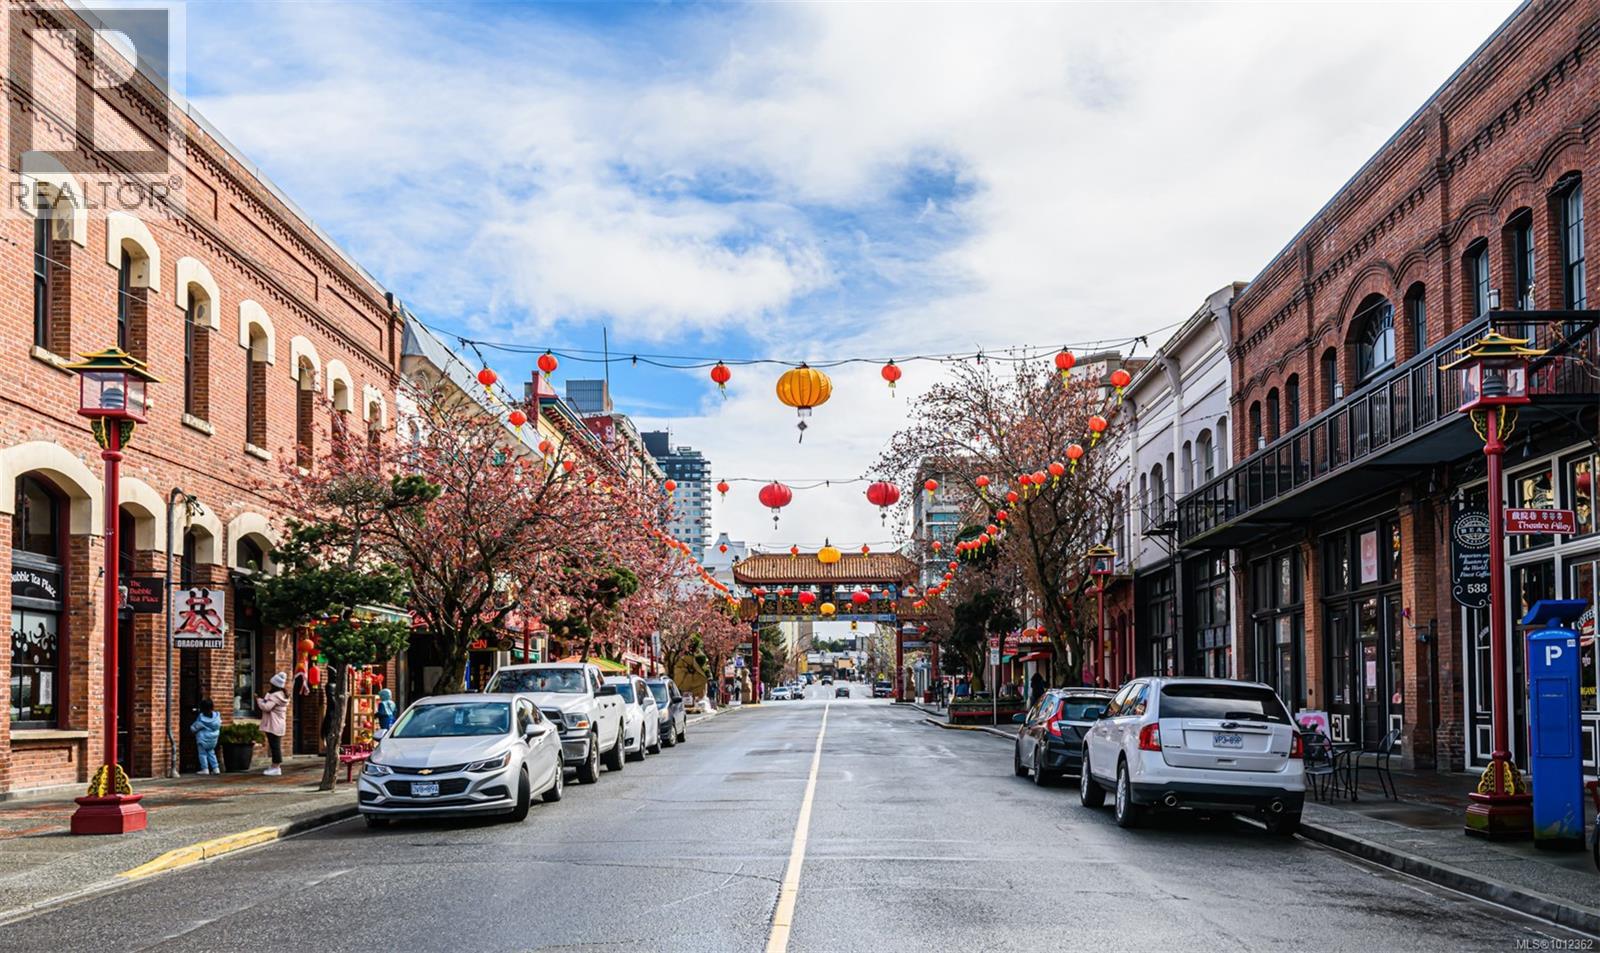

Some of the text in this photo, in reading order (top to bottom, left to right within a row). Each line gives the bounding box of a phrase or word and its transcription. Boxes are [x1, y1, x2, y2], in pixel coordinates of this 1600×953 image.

[1517, 521, 1571, 532] Theatre Alley
[11, 571, 57, 597] ubble Tea Place
[1467, 583, 1487, 593] 533
[177, 640, 222, 648] DRAGON ALLEY
[1546, 645, 1562, 666] P
